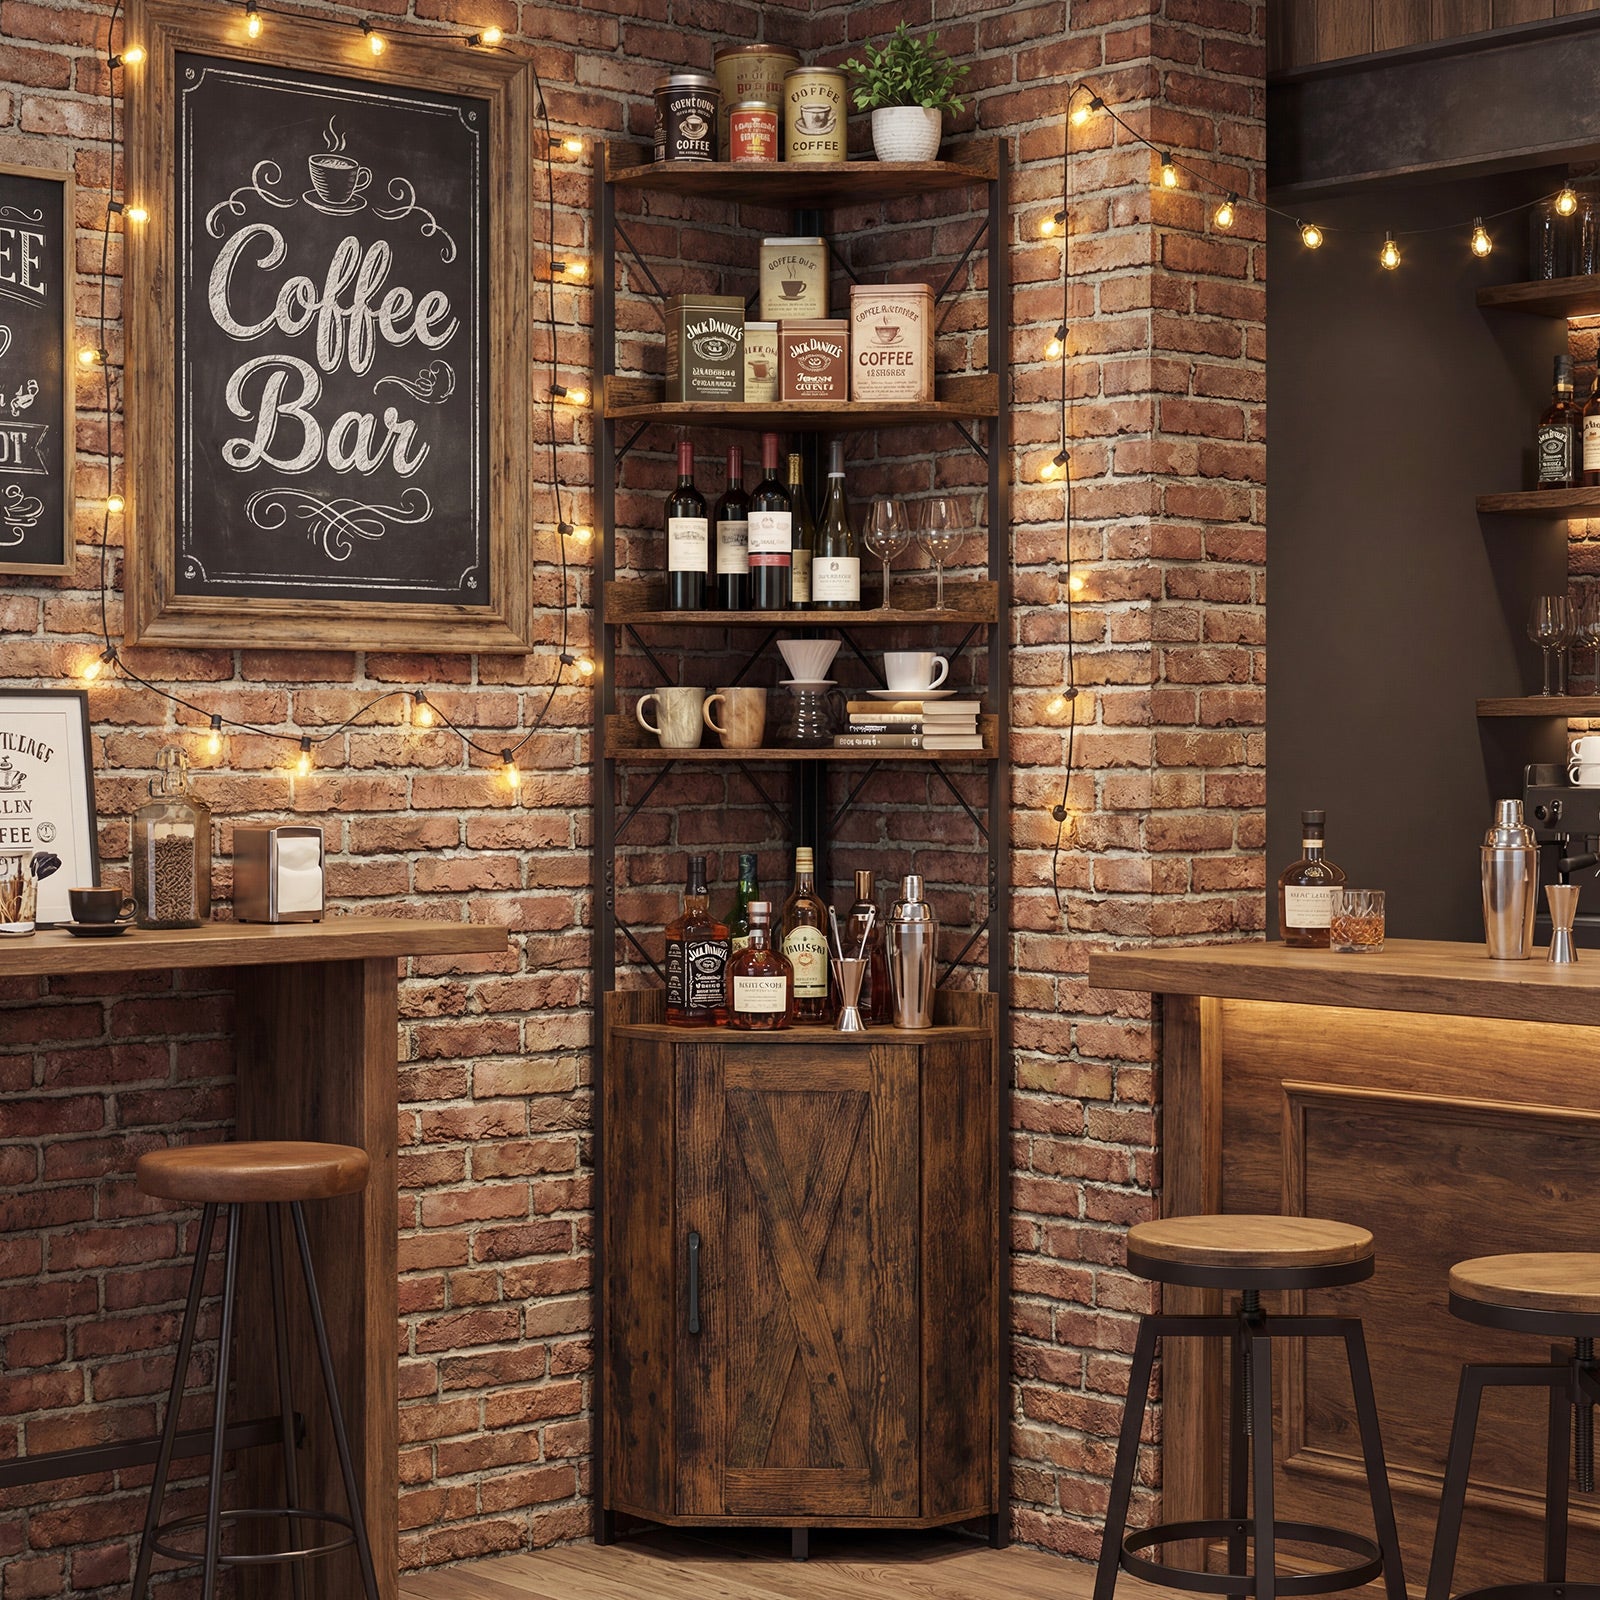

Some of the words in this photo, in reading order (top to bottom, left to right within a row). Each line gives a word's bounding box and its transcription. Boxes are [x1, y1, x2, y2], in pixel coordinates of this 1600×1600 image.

[676, 140, 710, 152] COFFEE
[792, 141, 839, 151] COFFEE
[208, 223, 460, 377] Coffee
[859, 351, 914, 366] COFFEE
[222, 354, 430, 478] Bar
